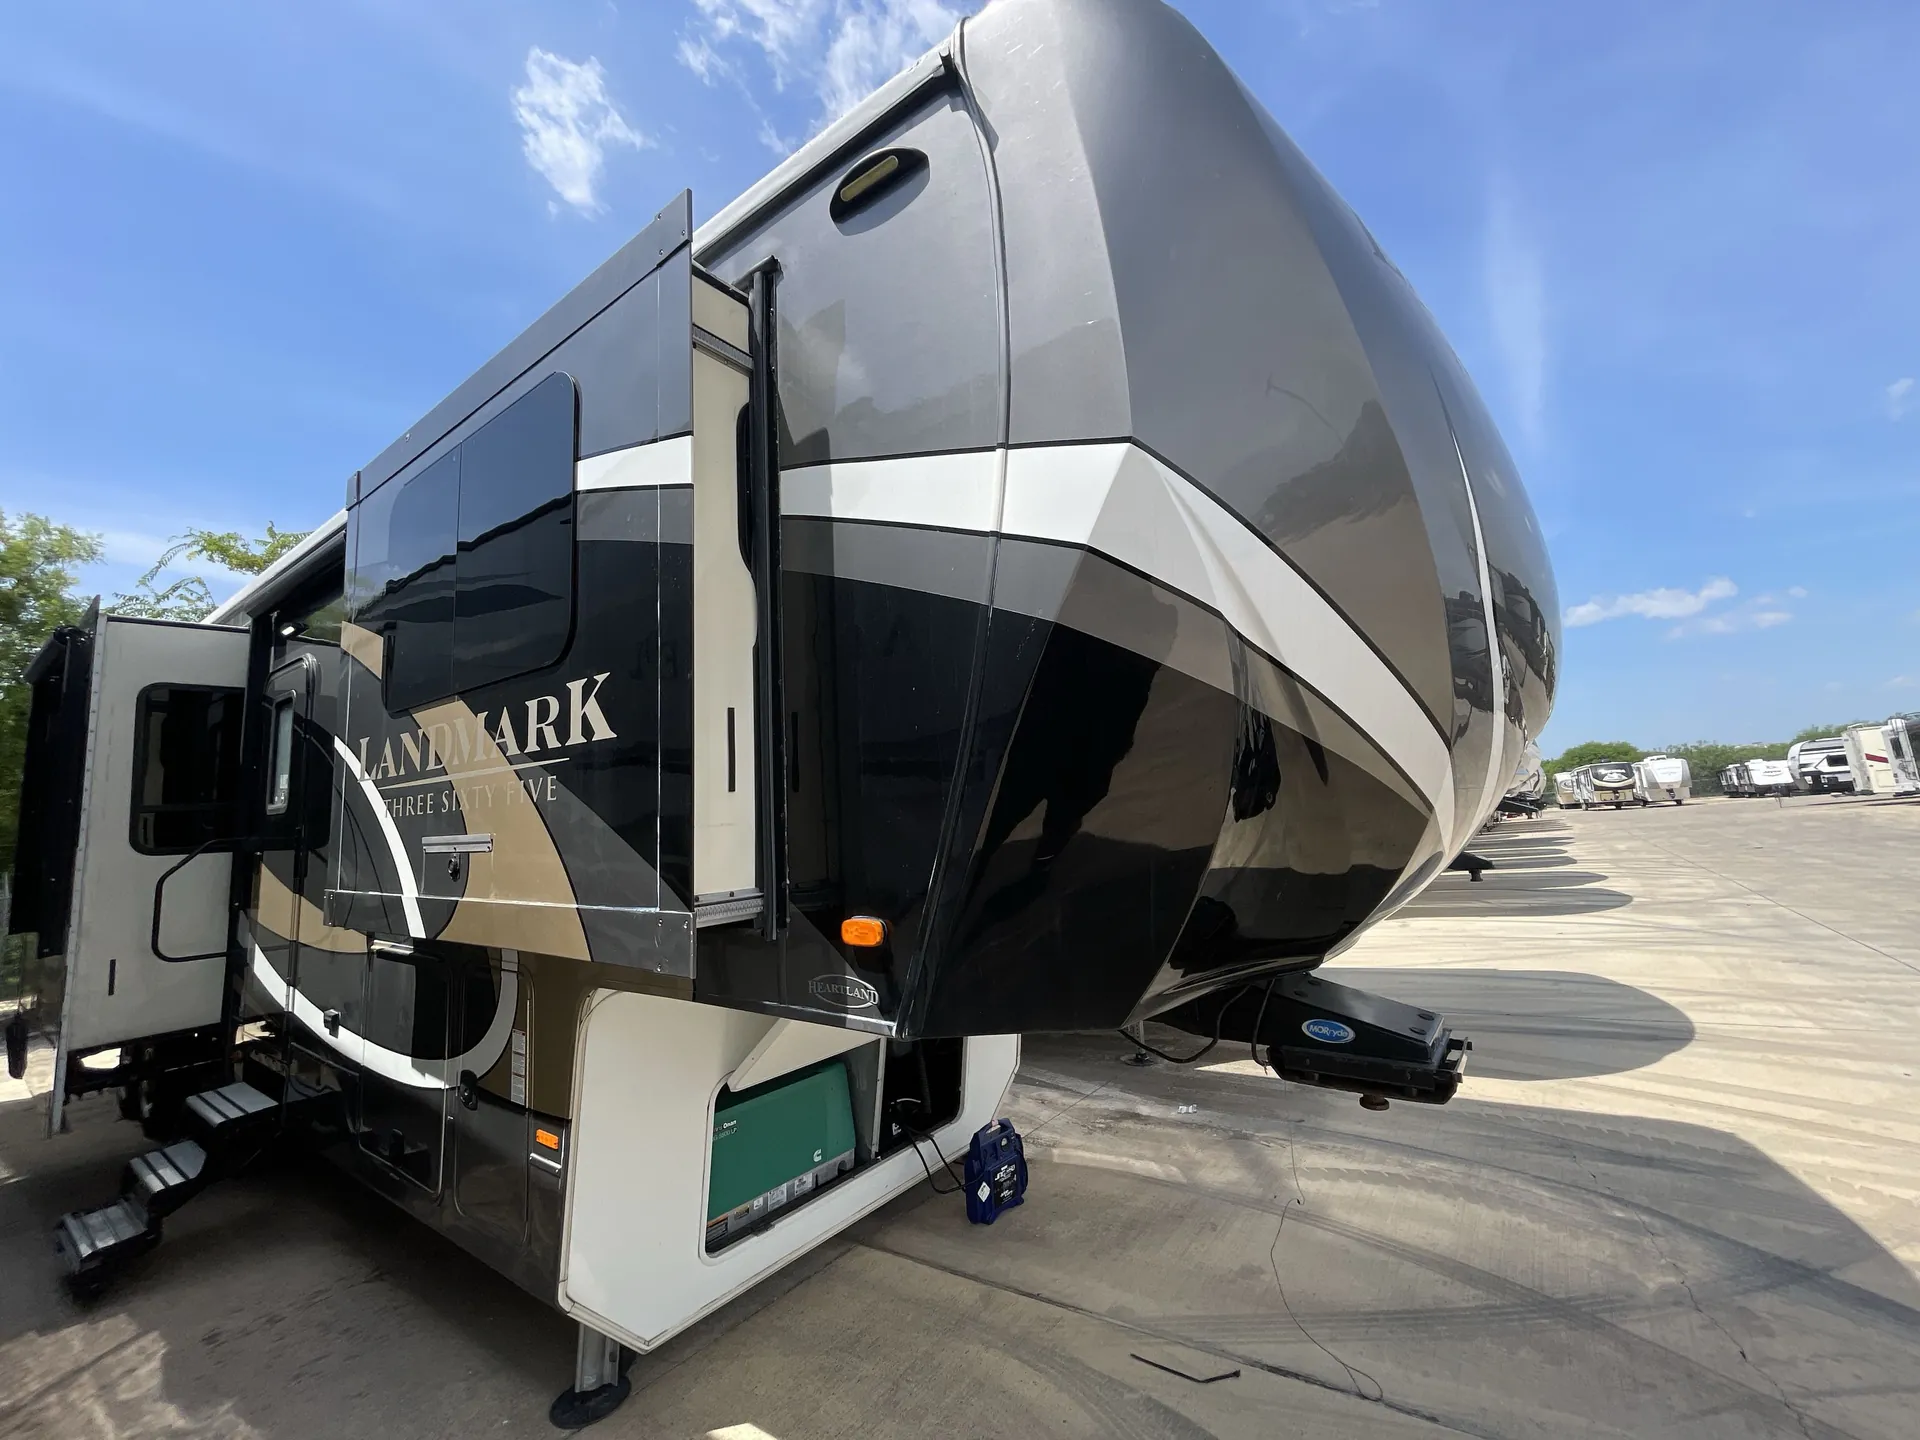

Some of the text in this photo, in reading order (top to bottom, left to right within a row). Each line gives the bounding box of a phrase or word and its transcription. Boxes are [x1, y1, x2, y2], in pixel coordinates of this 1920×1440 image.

[358, 671, 618, 783] LANDMARK
[384, 775, 557, 818] THREE SIXTY FIVE
[808, 981, 879, 1004] HEARTLAND
